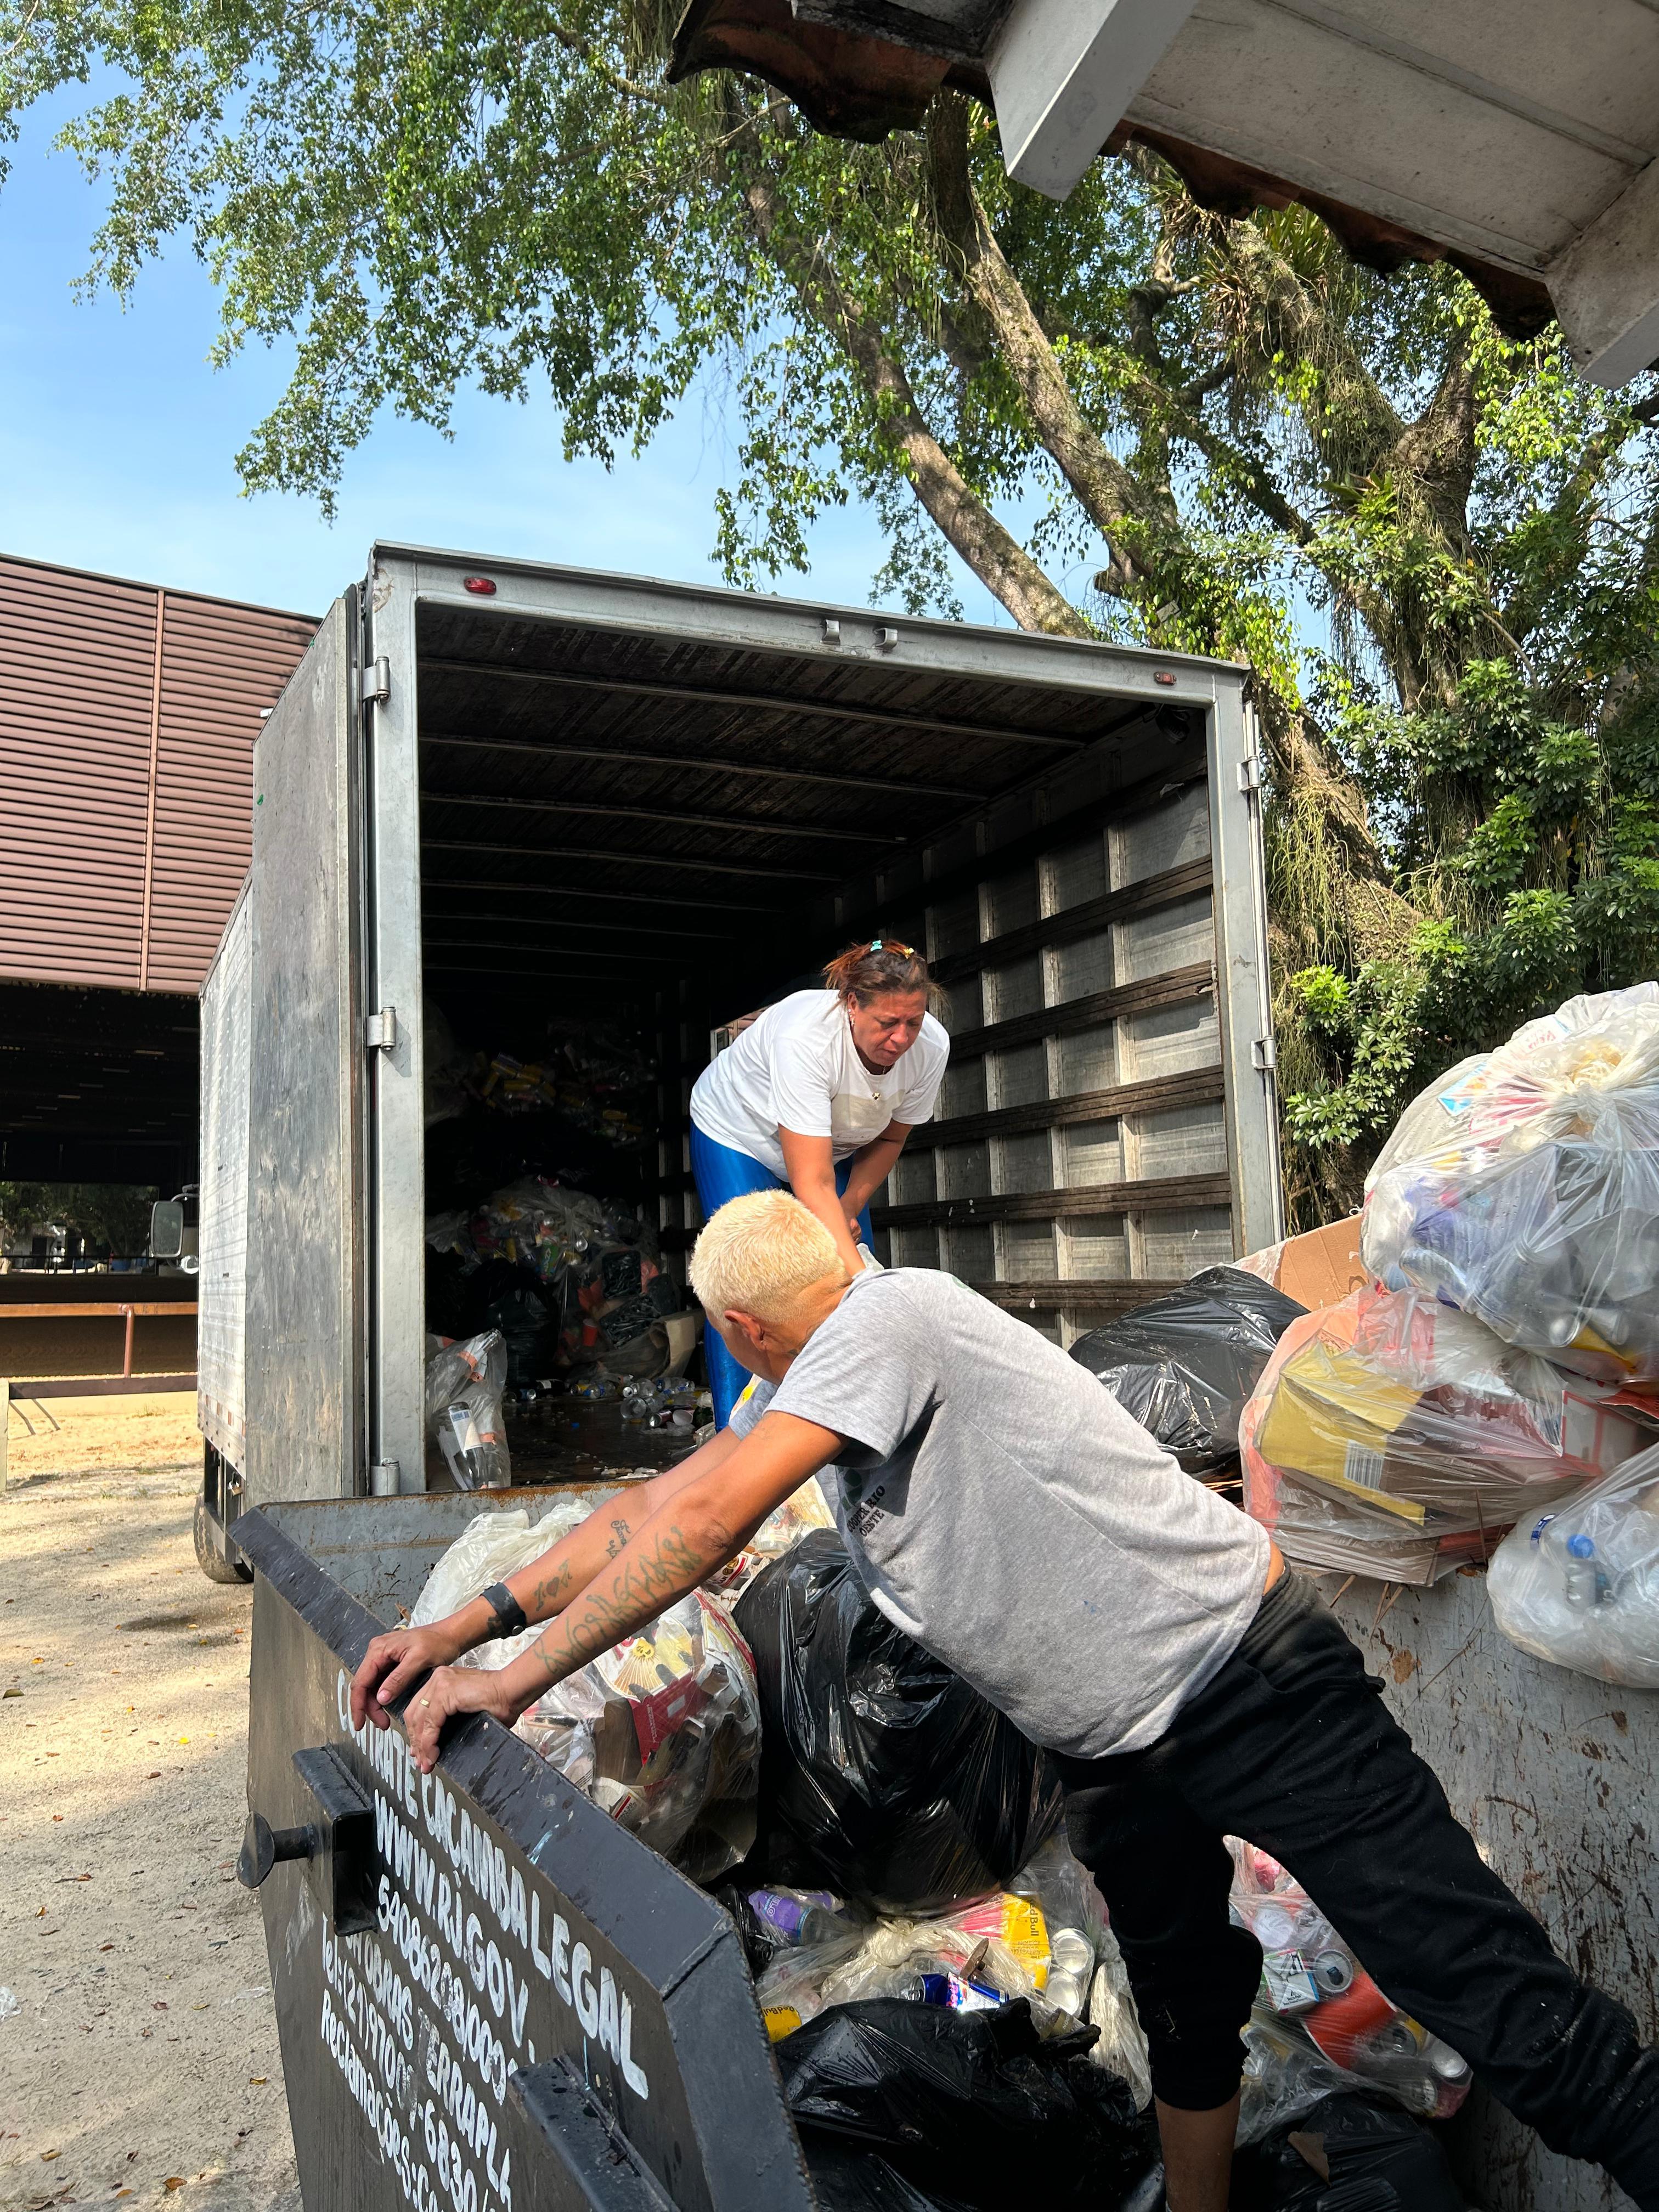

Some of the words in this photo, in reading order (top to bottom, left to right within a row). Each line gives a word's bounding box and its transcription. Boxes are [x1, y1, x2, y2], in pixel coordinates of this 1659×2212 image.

[865, 1485, 885, 1509] RIO
[859, 1509, 885, 1537] OESTE
[1030, 1917, 1040, 1937] Bull
[364, 1934, 414, 2051] OBRAS
[531, 1890, 649, 2100] LEGAL
